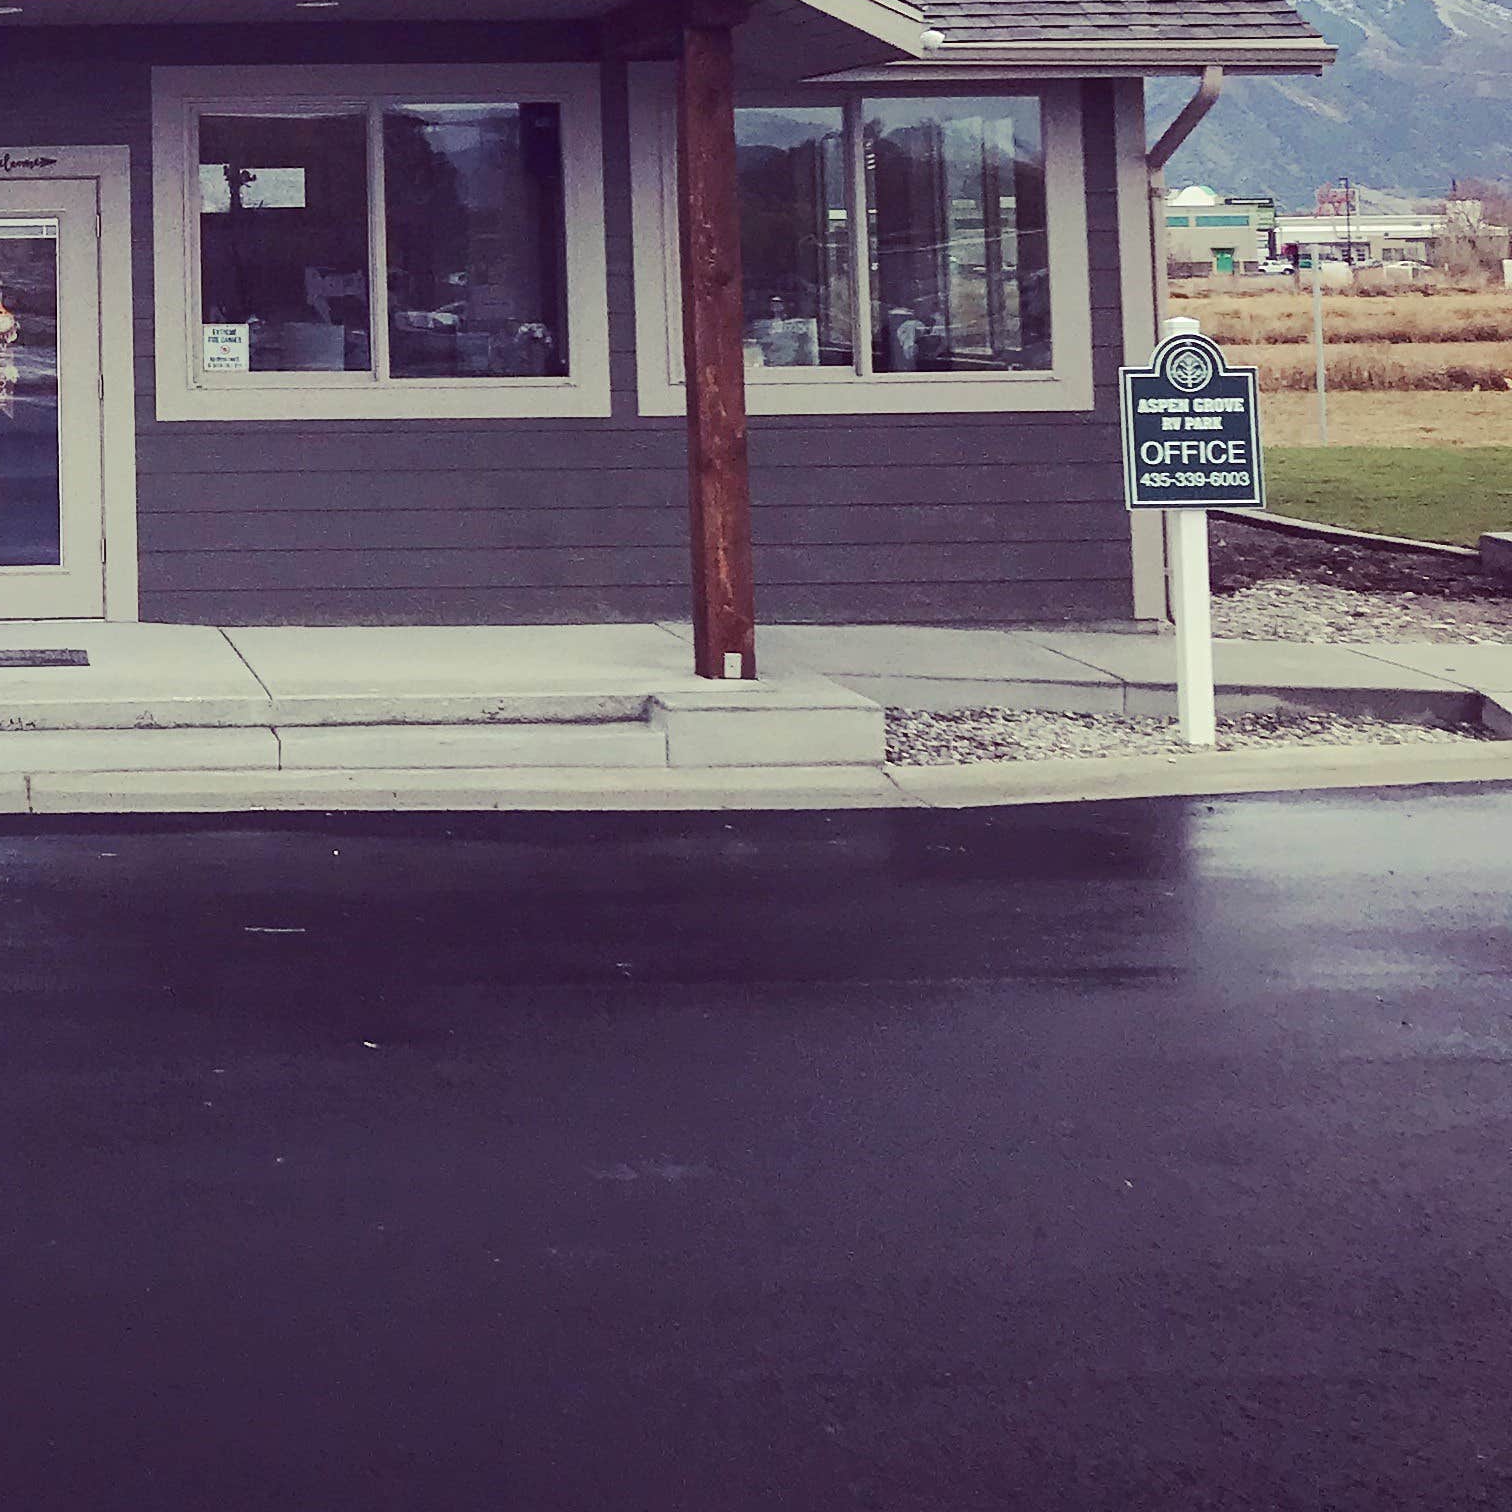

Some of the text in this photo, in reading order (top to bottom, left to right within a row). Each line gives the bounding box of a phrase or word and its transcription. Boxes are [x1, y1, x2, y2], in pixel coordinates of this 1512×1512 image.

[1137, 397, 1245, 413] ASPEN GROVE
[1161, 416, 1223, 430] RV PARK
[1140, 440, 1247, 465] OFFICE
[1139, 471, 1251, 487] 435-339-6003
